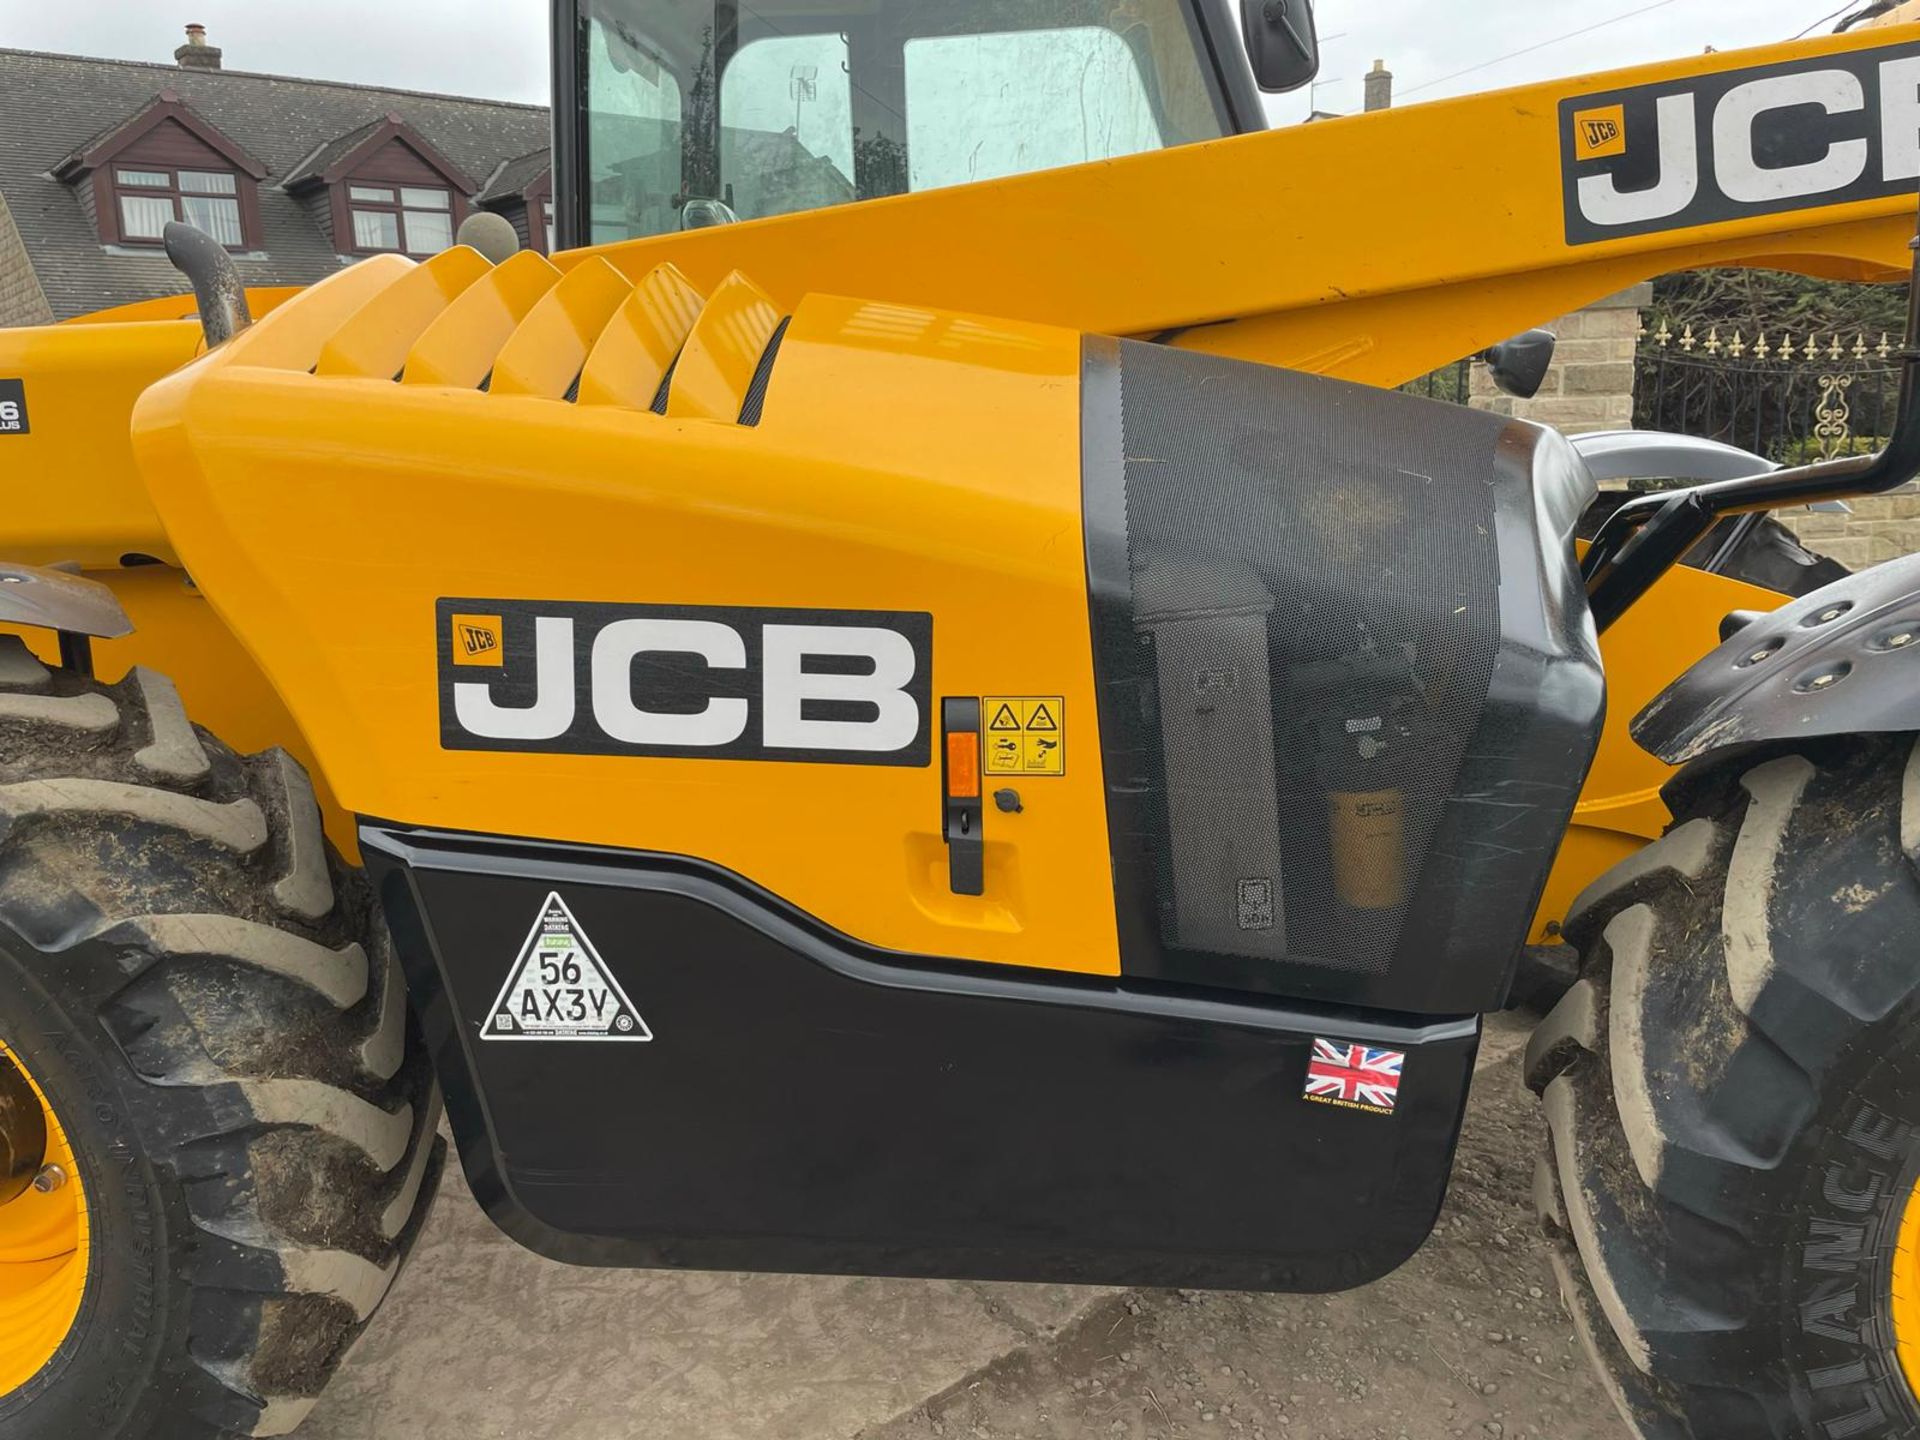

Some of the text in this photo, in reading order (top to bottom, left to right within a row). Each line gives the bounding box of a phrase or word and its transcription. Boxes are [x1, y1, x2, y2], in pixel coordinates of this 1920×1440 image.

[1577, 56, 1919, 225] JC
[1588, 119, 1617, 145] JCB
[465, 626, 496, 654] JCB
[454, 616, 919, 751] JCB
[539, 952, 582, 985] 56
[521, 989, 608, 1021] AX3Y
[1310, 1096, 1332, 1104] GREAT
[1332, 1099, 1360, 1109] BRITISH
[1360, 1104, 1393, 1114] PRODUCT
